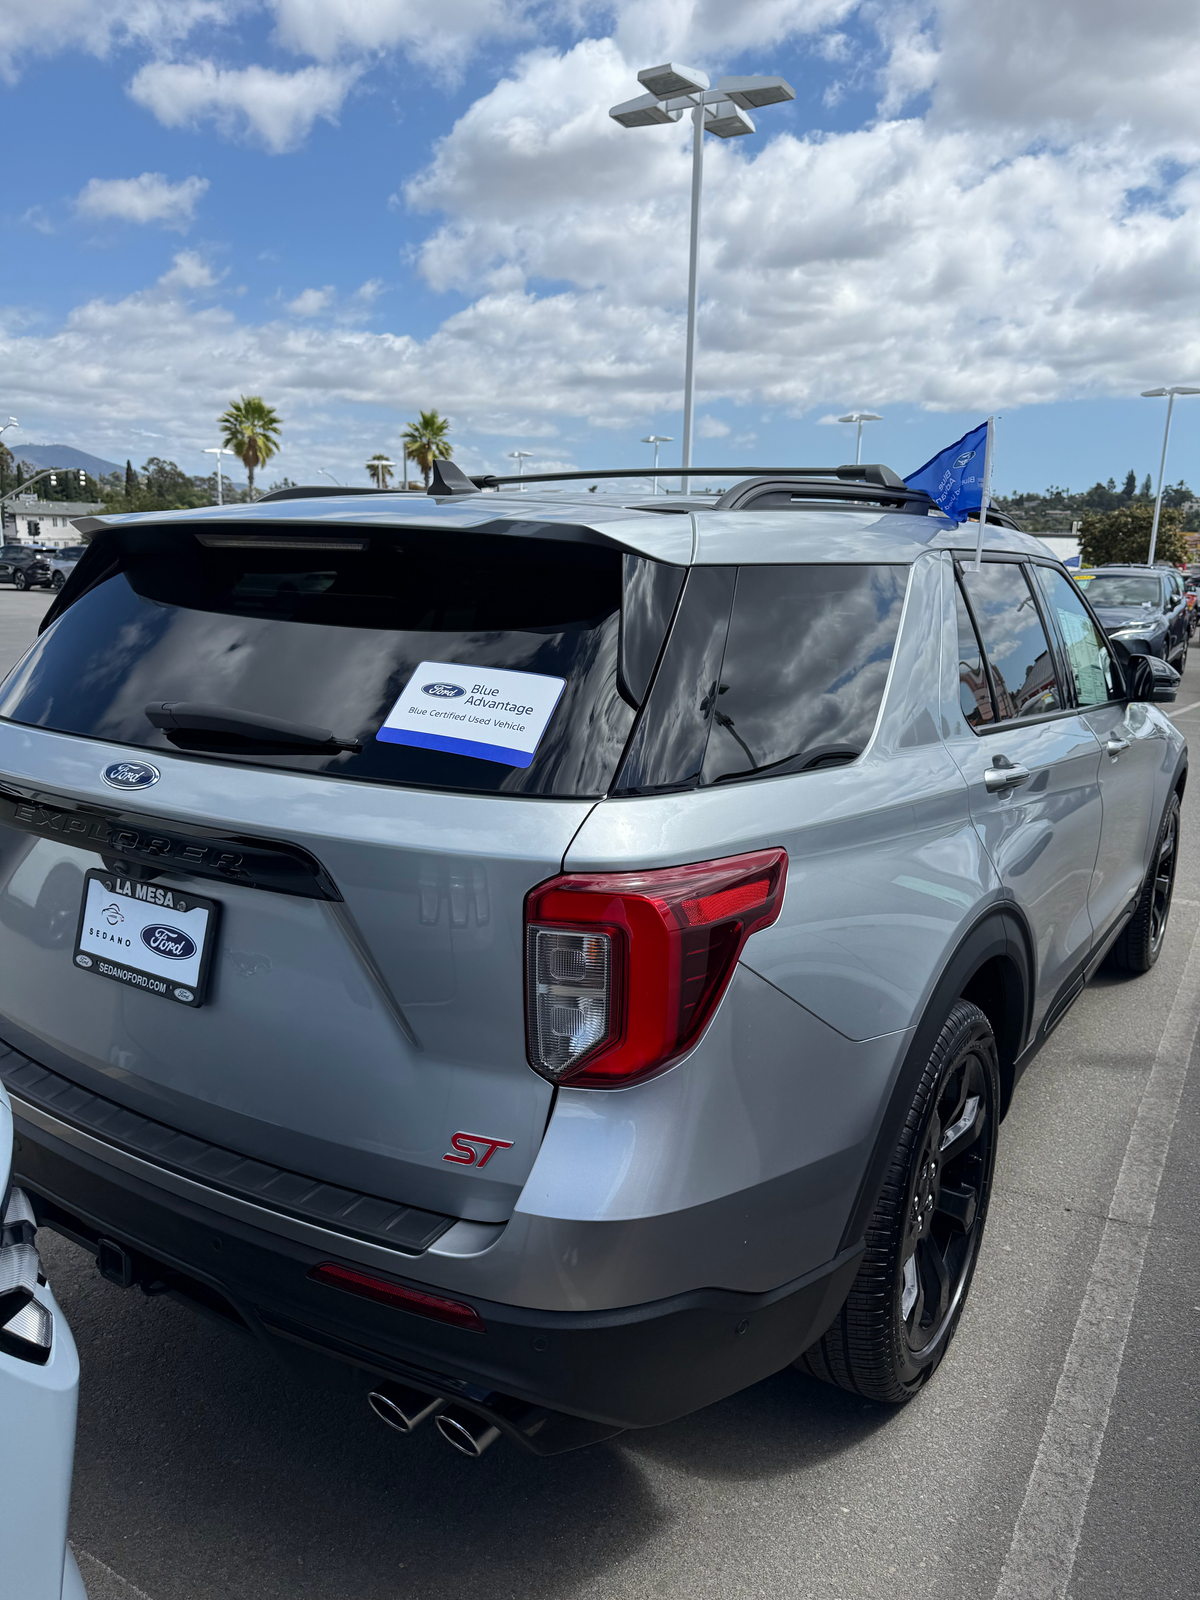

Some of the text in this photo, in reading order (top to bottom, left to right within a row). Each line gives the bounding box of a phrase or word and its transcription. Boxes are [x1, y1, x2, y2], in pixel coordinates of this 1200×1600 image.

[428, 682, 460, 698] Ford
[470, 683, 500, 697] Blue
[464, 695, 534, 716] Advantage
[408, 706, 526, 732] Blue Certified Used Vehicle
[109, 763, 146, 783] Ford
[14, 802, 250, 878] EXPLORER
[115, 878, 174, 908] LA MESA
[89, 927, 131, 948] SEDANO
[149, 927, 185, 956] Ford
[99, 961, 167, 994] SEDANOFORD.COM
[442, 1130, 515, 1169] ST
